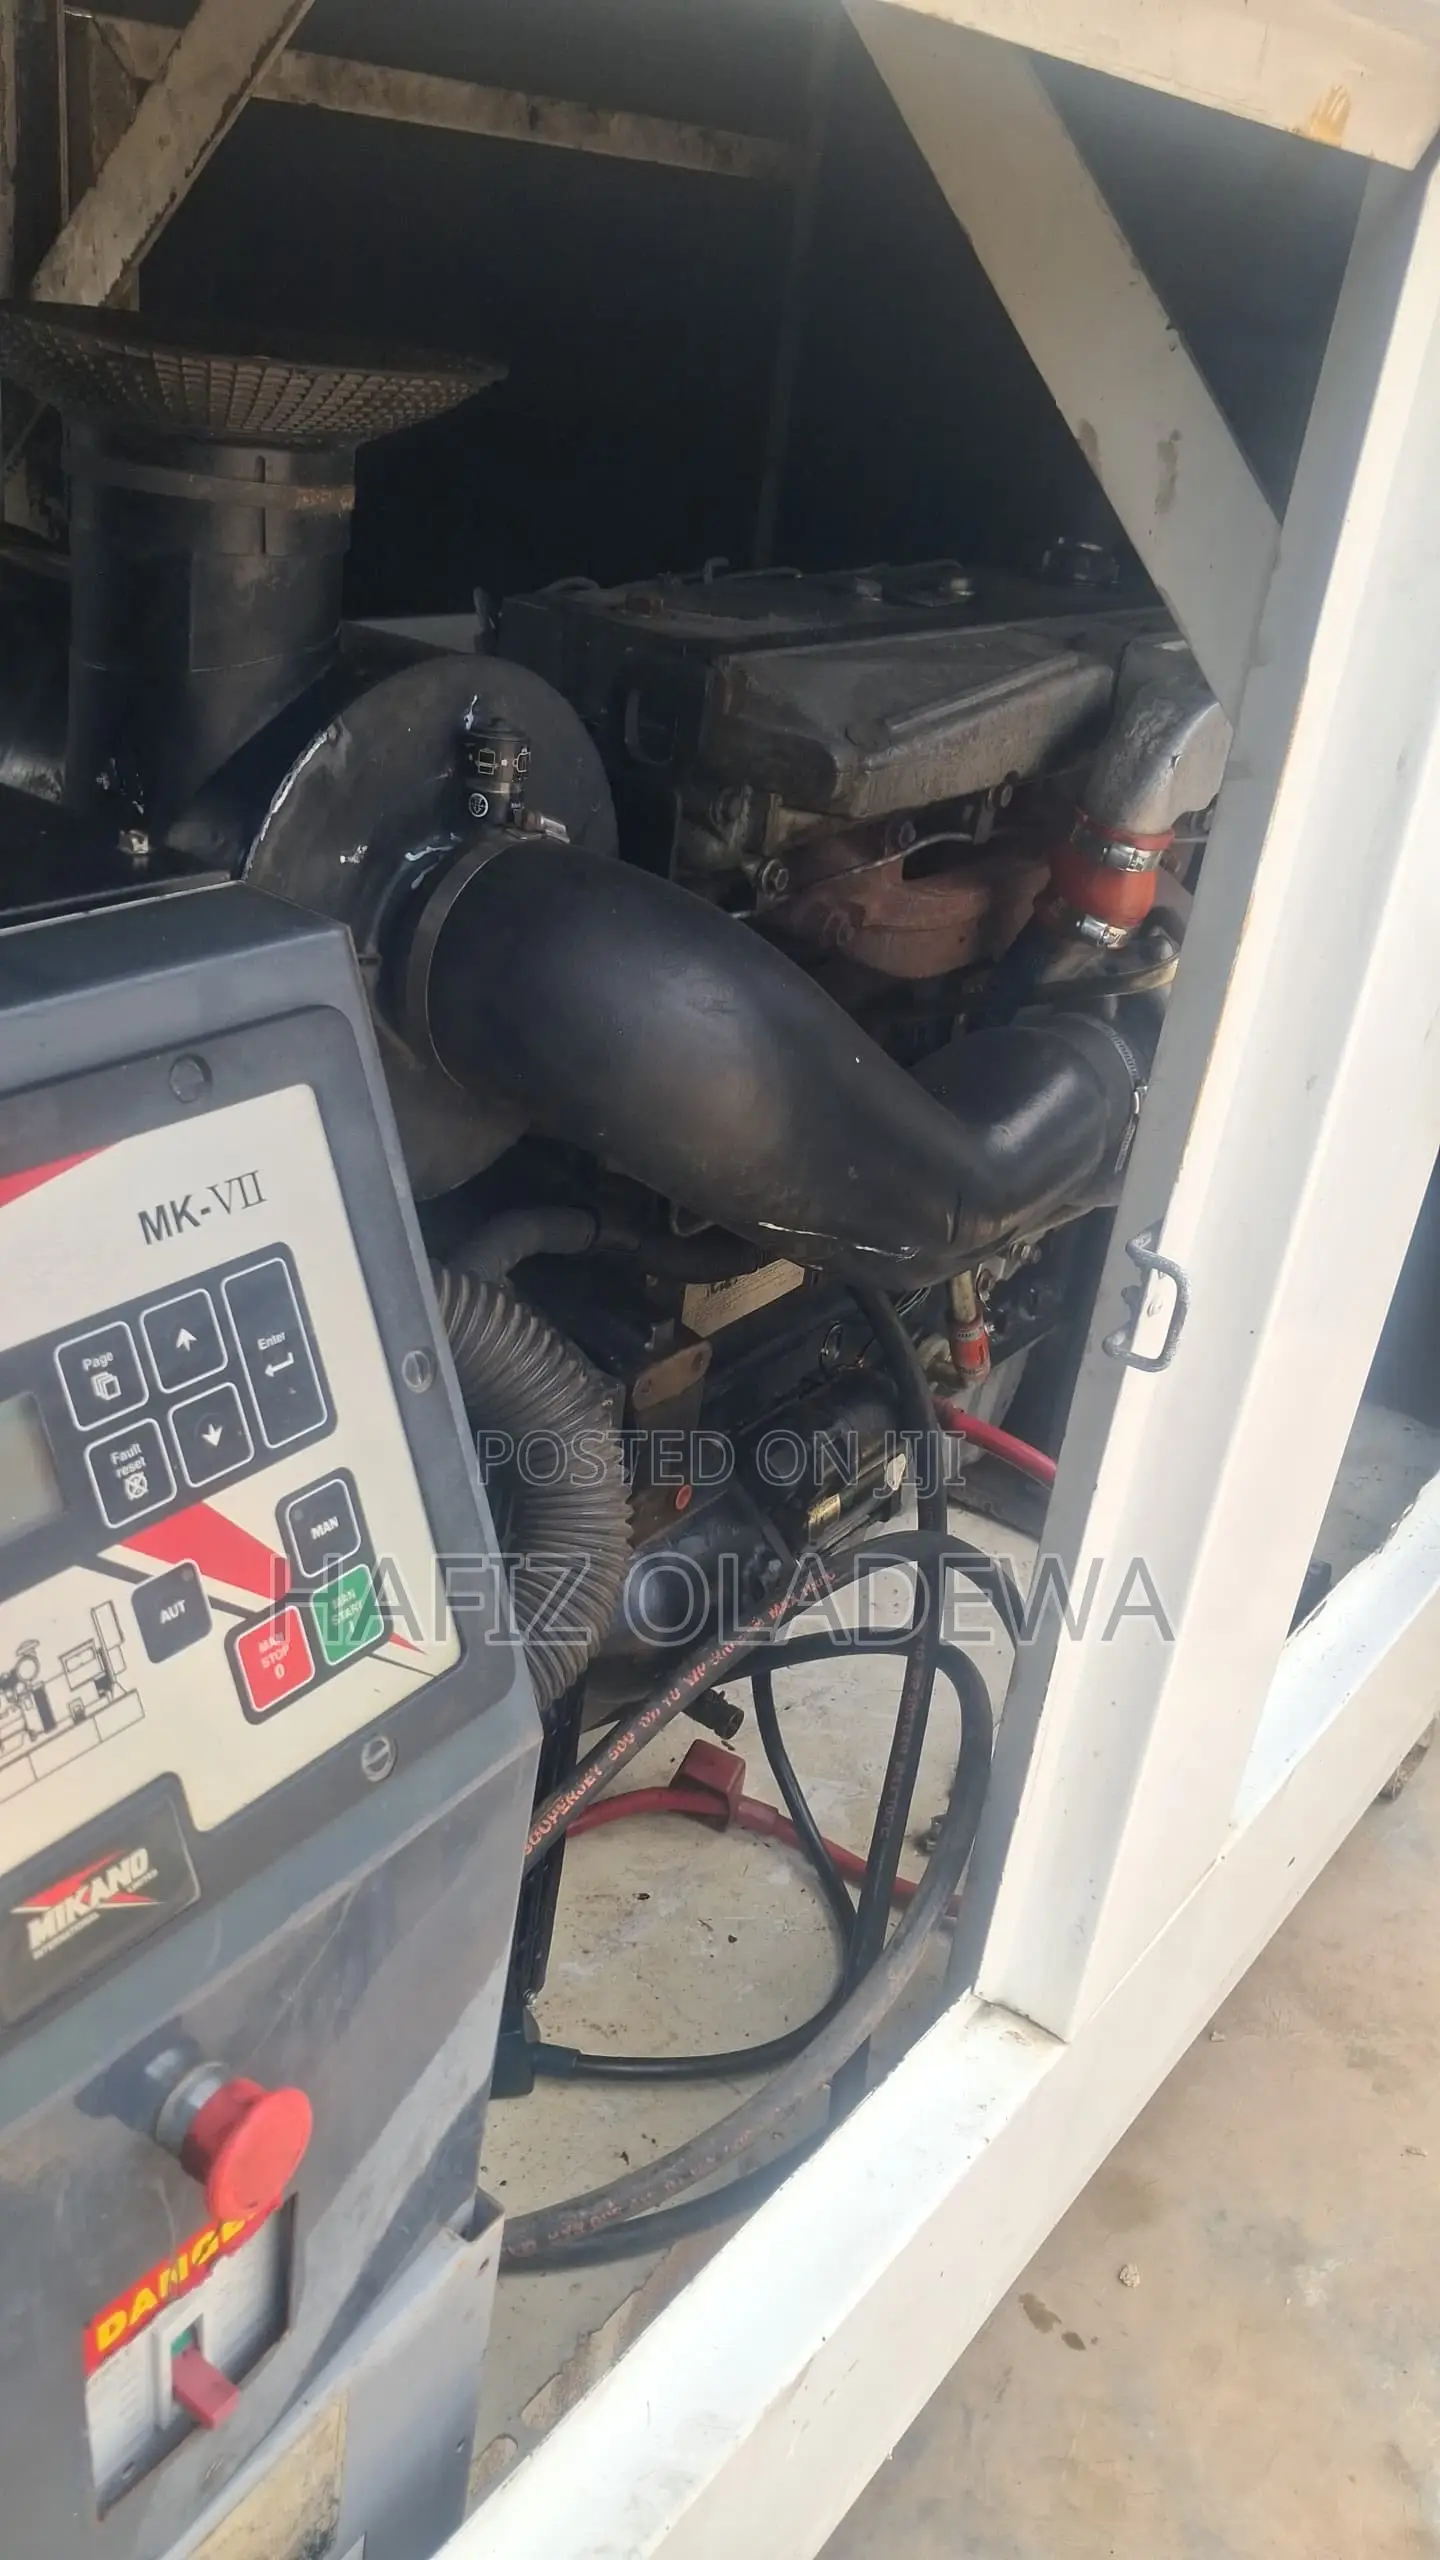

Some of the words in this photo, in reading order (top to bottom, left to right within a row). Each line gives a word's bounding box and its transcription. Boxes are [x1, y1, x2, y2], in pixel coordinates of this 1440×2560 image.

[138, 1169, 268, 1245] MK-VII
[257, 1331, 286, 1350] Enter
[82, 1352, 114, 1371] Page
[110, 1443, 142, 1465] Fault
[115, 1456, 146, 1479] reset
[310, 1516, 339, 1540] MAN
[160, 1599, 186, 1625] AUT
[261, 1643, 290, 1669] STOP
[27, 1847, 149, 1951] MIKANO
[96, 2212, 256, 2352] DANGE
